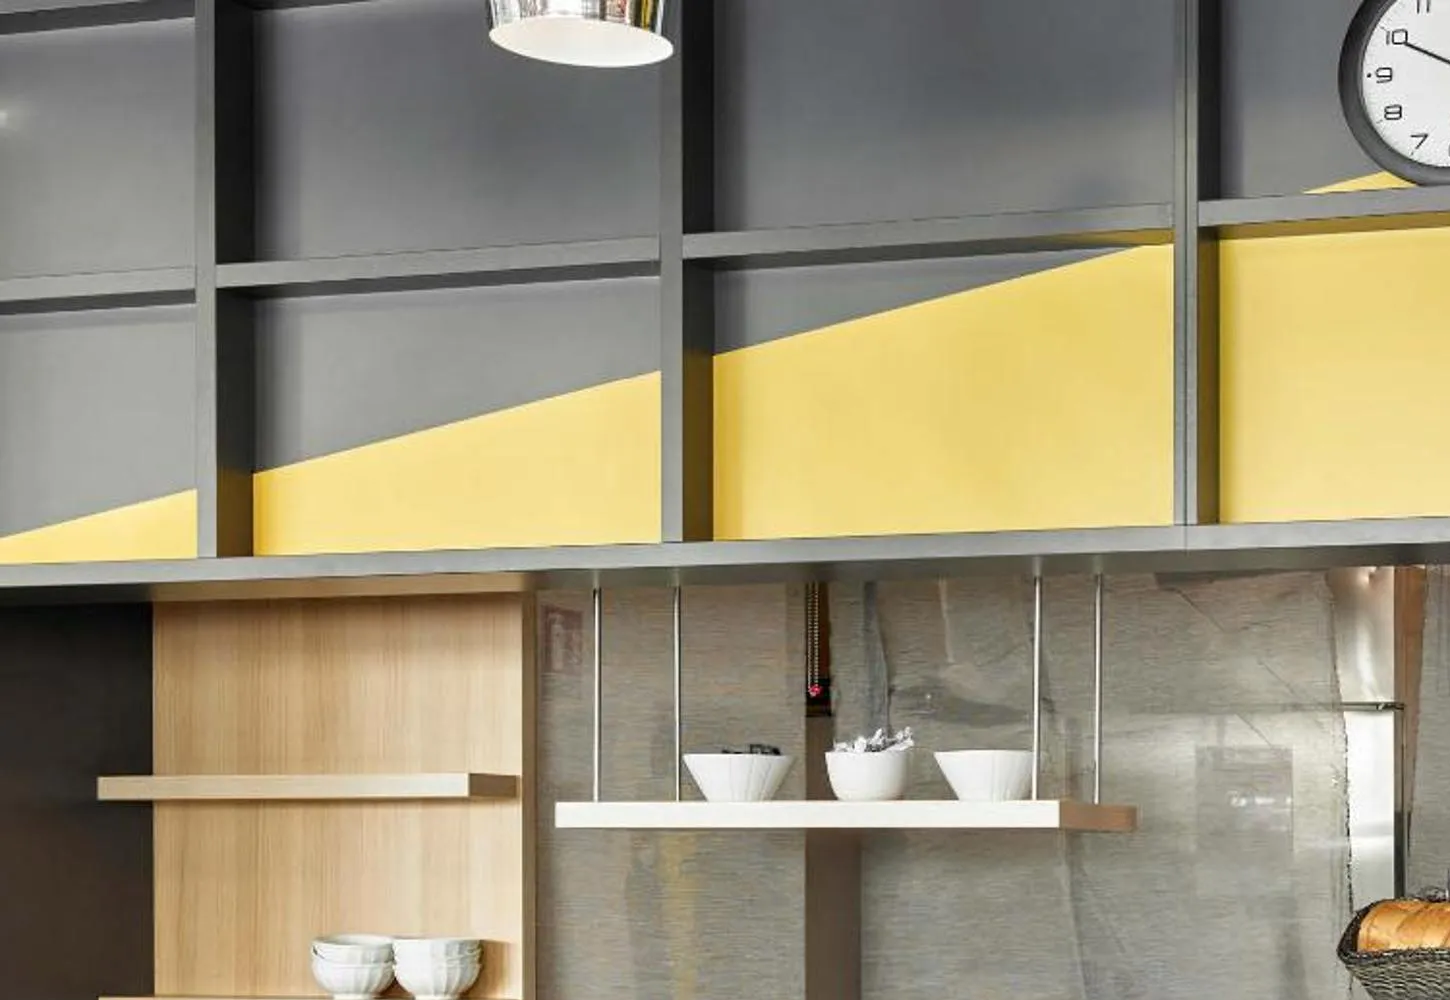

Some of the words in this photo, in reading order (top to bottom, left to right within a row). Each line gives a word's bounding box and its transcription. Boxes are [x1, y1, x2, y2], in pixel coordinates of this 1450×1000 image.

[1386, 28, 1409, 46] 10
[1375, 66, 1393, 84] 9
[1384, 104, 1403, 121] 8
[1410, 133, 1429, 150] 7
